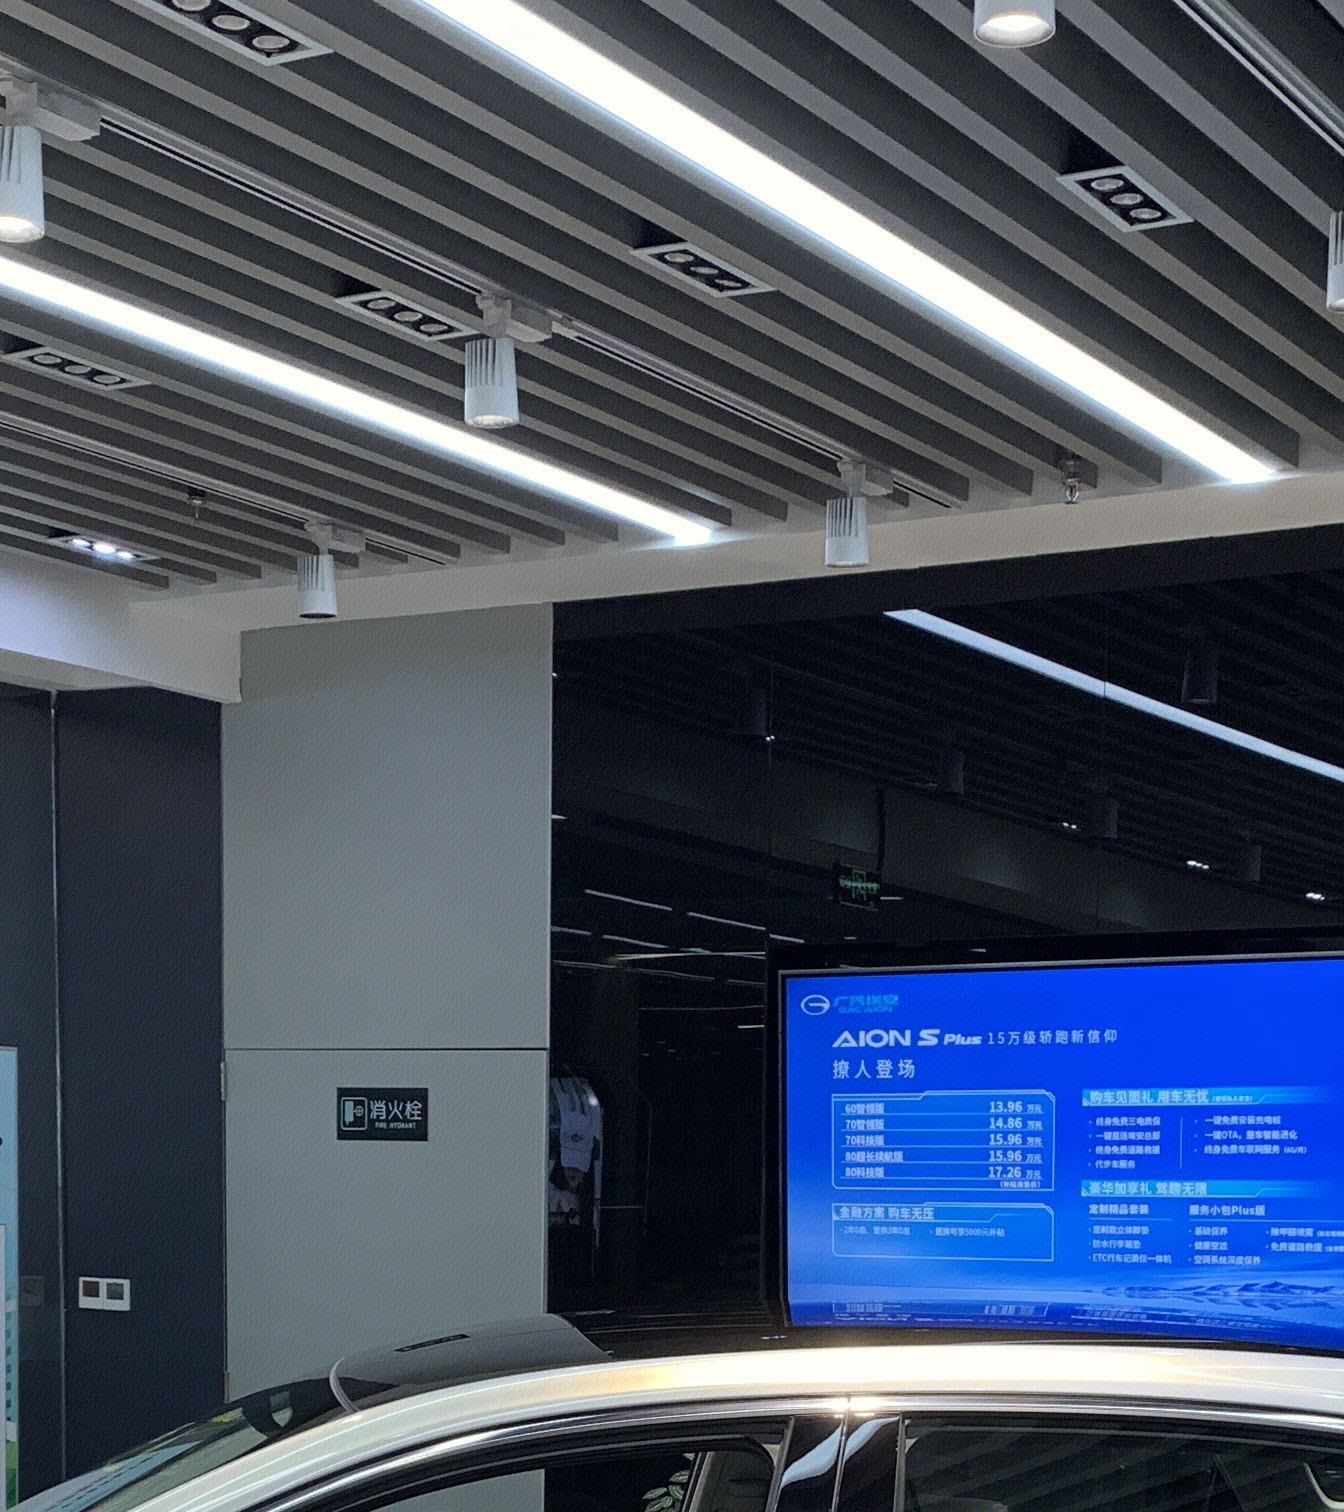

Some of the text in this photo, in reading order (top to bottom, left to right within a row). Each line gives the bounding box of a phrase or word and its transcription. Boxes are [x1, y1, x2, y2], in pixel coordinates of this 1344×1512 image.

[832, 1029, 1118, 1048] AION S Plus 15万级轿跑新信仰
[832, 1059, 916, 1080] 撩人登场
[1089, 1090, 1154, 1104] 购车见面礼
[1157, 1089, 1209, 1104] 用车无忧
[370, 1100, 422, 1120] 消火栓
[988, 1100, 1023, 1113] 13.96
[1026, 1104, 1043, 1114] 万元
[988, 1117, 1023, 1130] 14.86
[1026, 1120, 1043, 1130] 万元
[988, 1133, 1023, 1146] 15.96
[1026, 1136, 1043, 1146] 万元
[988, 1150, 1023, 1162] 15.96
[1026, 1153, 1043, 1163] 万元
[988, 1166, 1023, 1178] 17.26
[1026, 1170, 1043, 1180] 万元
[1088, 1181, 1208, 1196] 豪华加享礼 驾趣无限
[839, 1206, 935, 1220] 金融方案 购车无压
[1088, 1204, 1150, 1216] 定制精品套装
[1188, 1204, 1266, 1217] 服务小包Plus版
